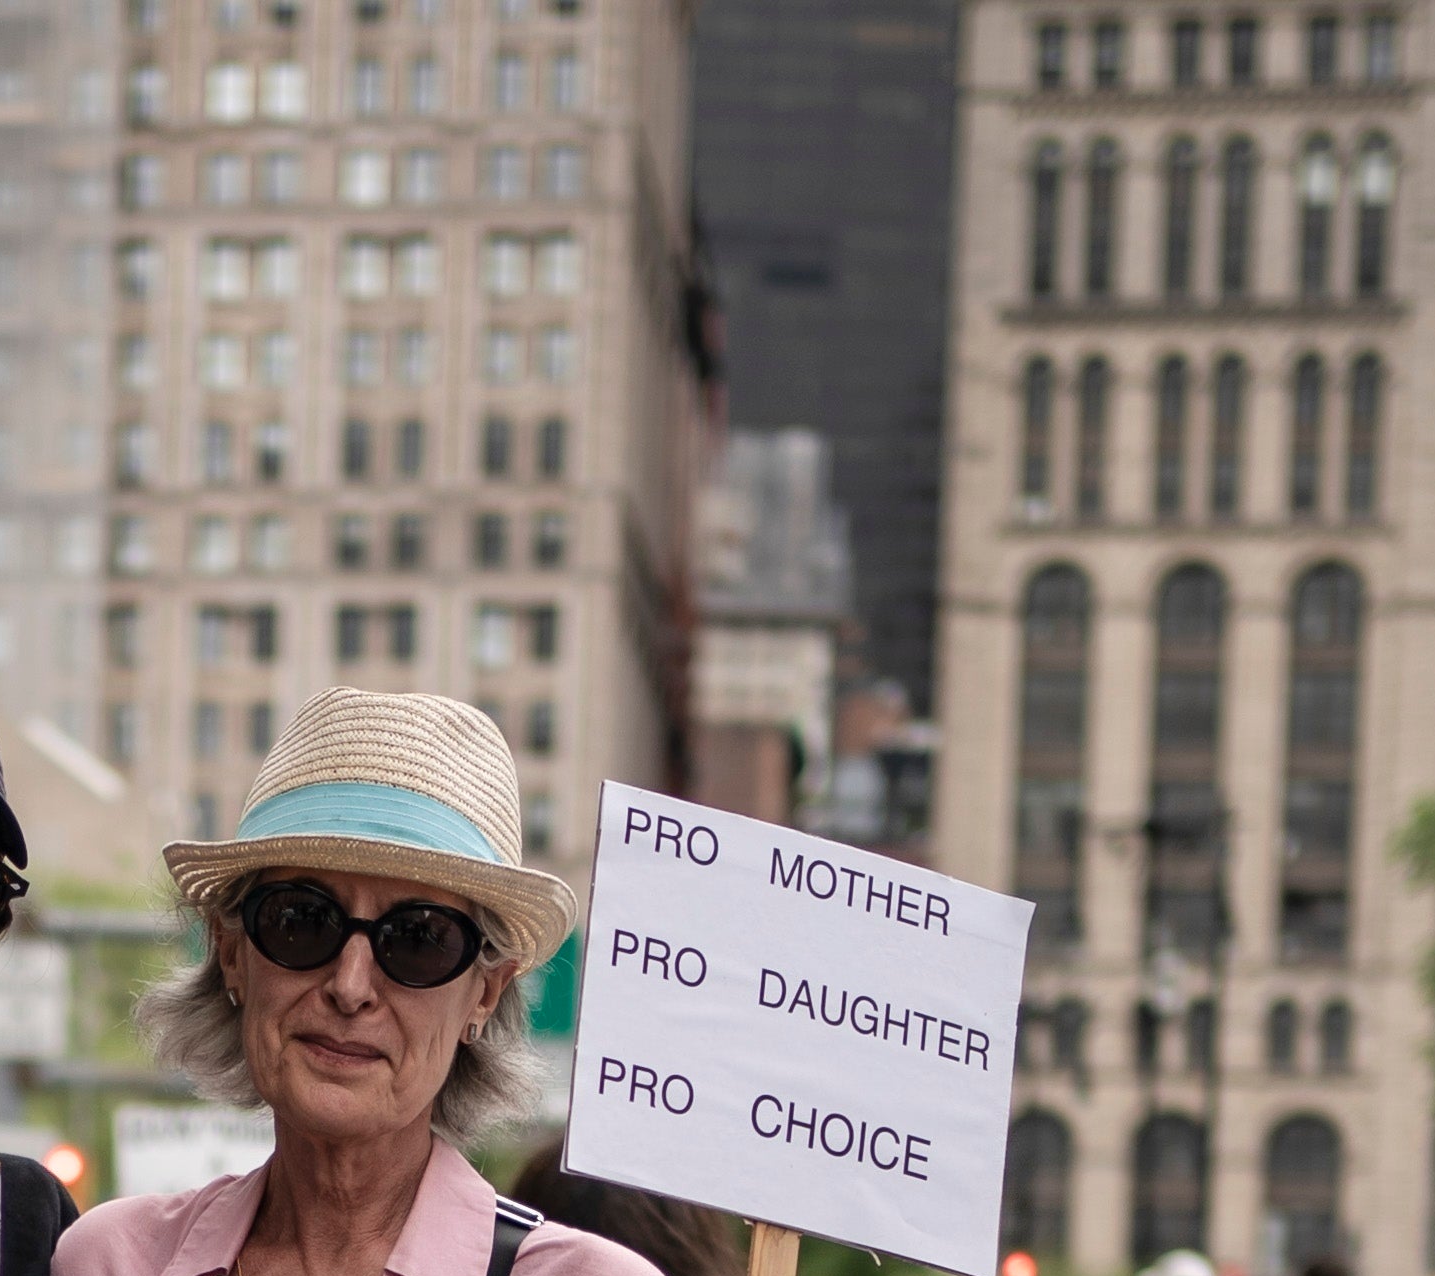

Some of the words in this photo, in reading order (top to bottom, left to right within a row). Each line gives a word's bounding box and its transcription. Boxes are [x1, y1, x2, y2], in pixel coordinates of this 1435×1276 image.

[623, 806, 720, 866] PRO
[769, 847, 951, 936] MOTHER
[610, 928, 708, 988] PRO
[757, 968, 991, 1071] DAUGHTER
[597, 1056, 695, 1115] PRO
[750, 1093, 932, 1181] CHOICE
